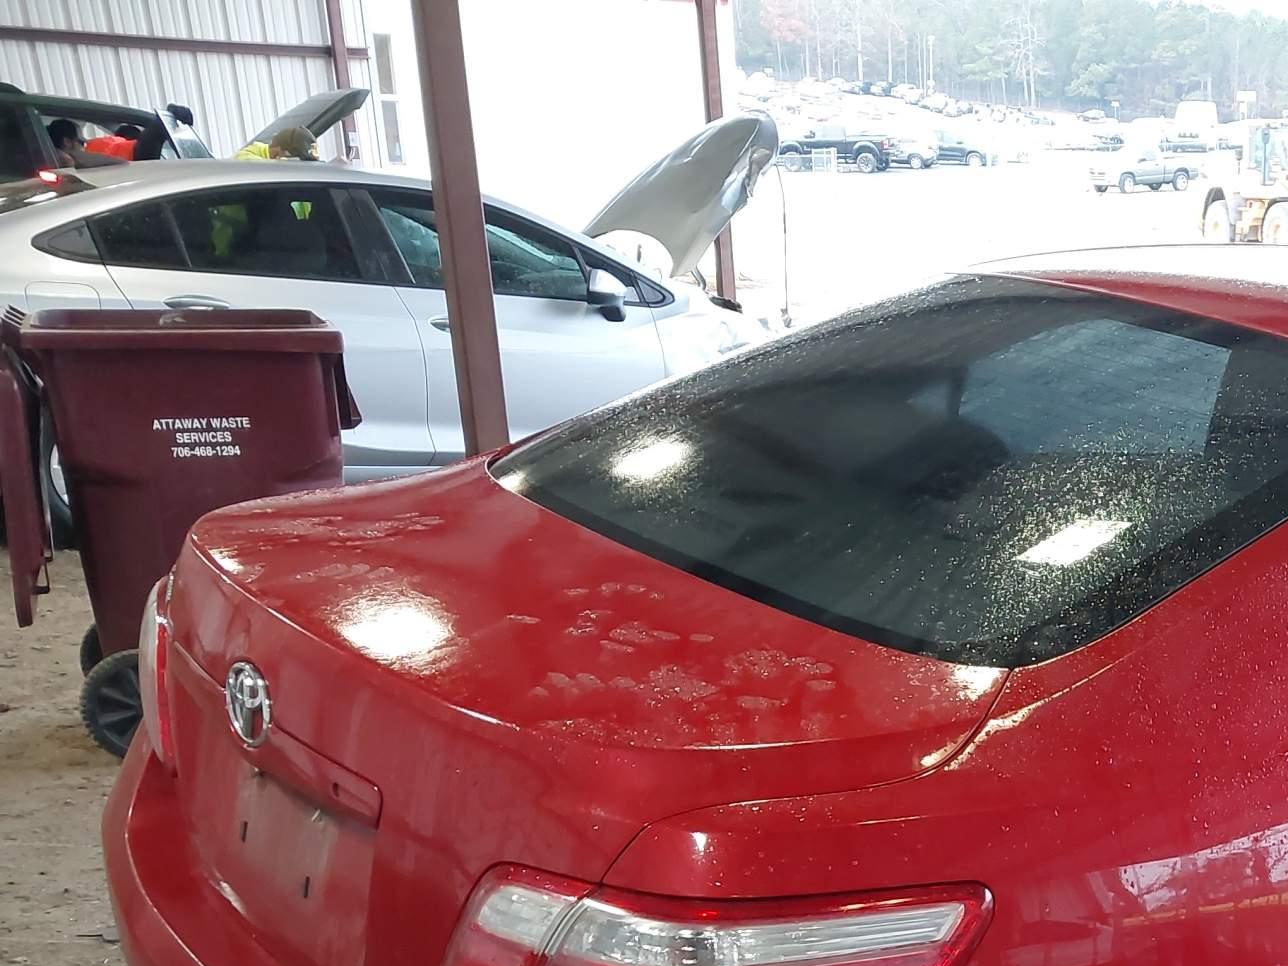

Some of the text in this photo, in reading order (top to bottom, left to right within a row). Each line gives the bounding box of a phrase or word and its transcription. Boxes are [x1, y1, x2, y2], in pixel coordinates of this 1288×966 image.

[152, 417, 251, 430] ATTAWAY WASTE
[175, 431, 233, 443] SERVICES
[171, 445, 241, 458] 706-468-1294
